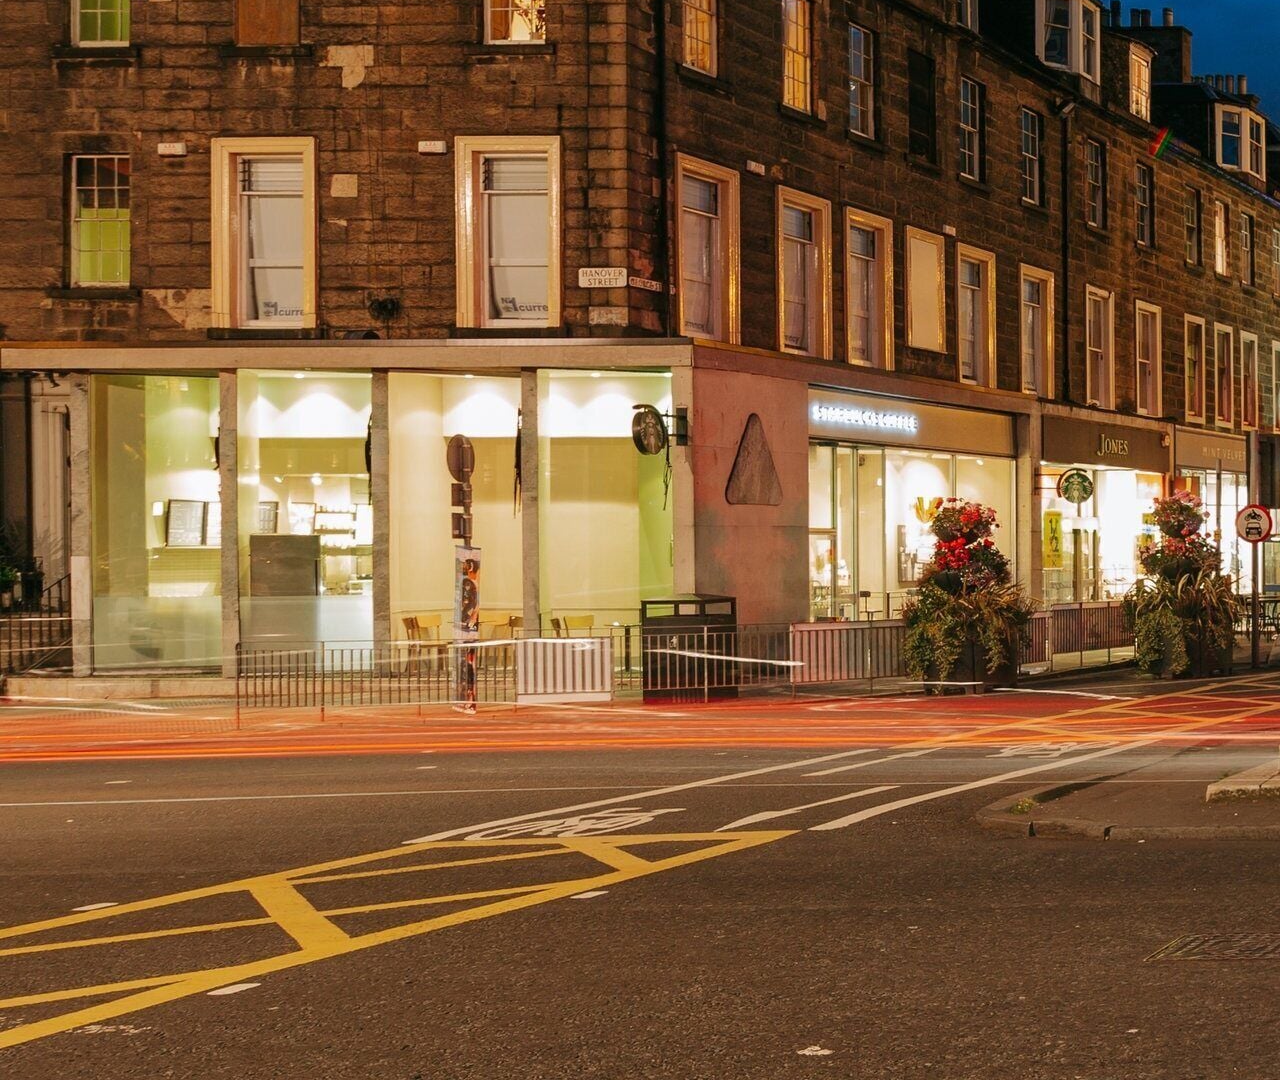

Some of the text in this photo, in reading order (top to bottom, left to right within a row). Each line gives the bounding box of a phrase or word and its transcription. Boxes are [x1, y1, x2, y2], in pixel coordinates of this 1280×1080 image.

[582, 269, 624, 278] HANOVER
[587, 278, 619, 286] STREET
[1097, 433, 1129, 456] JONES
